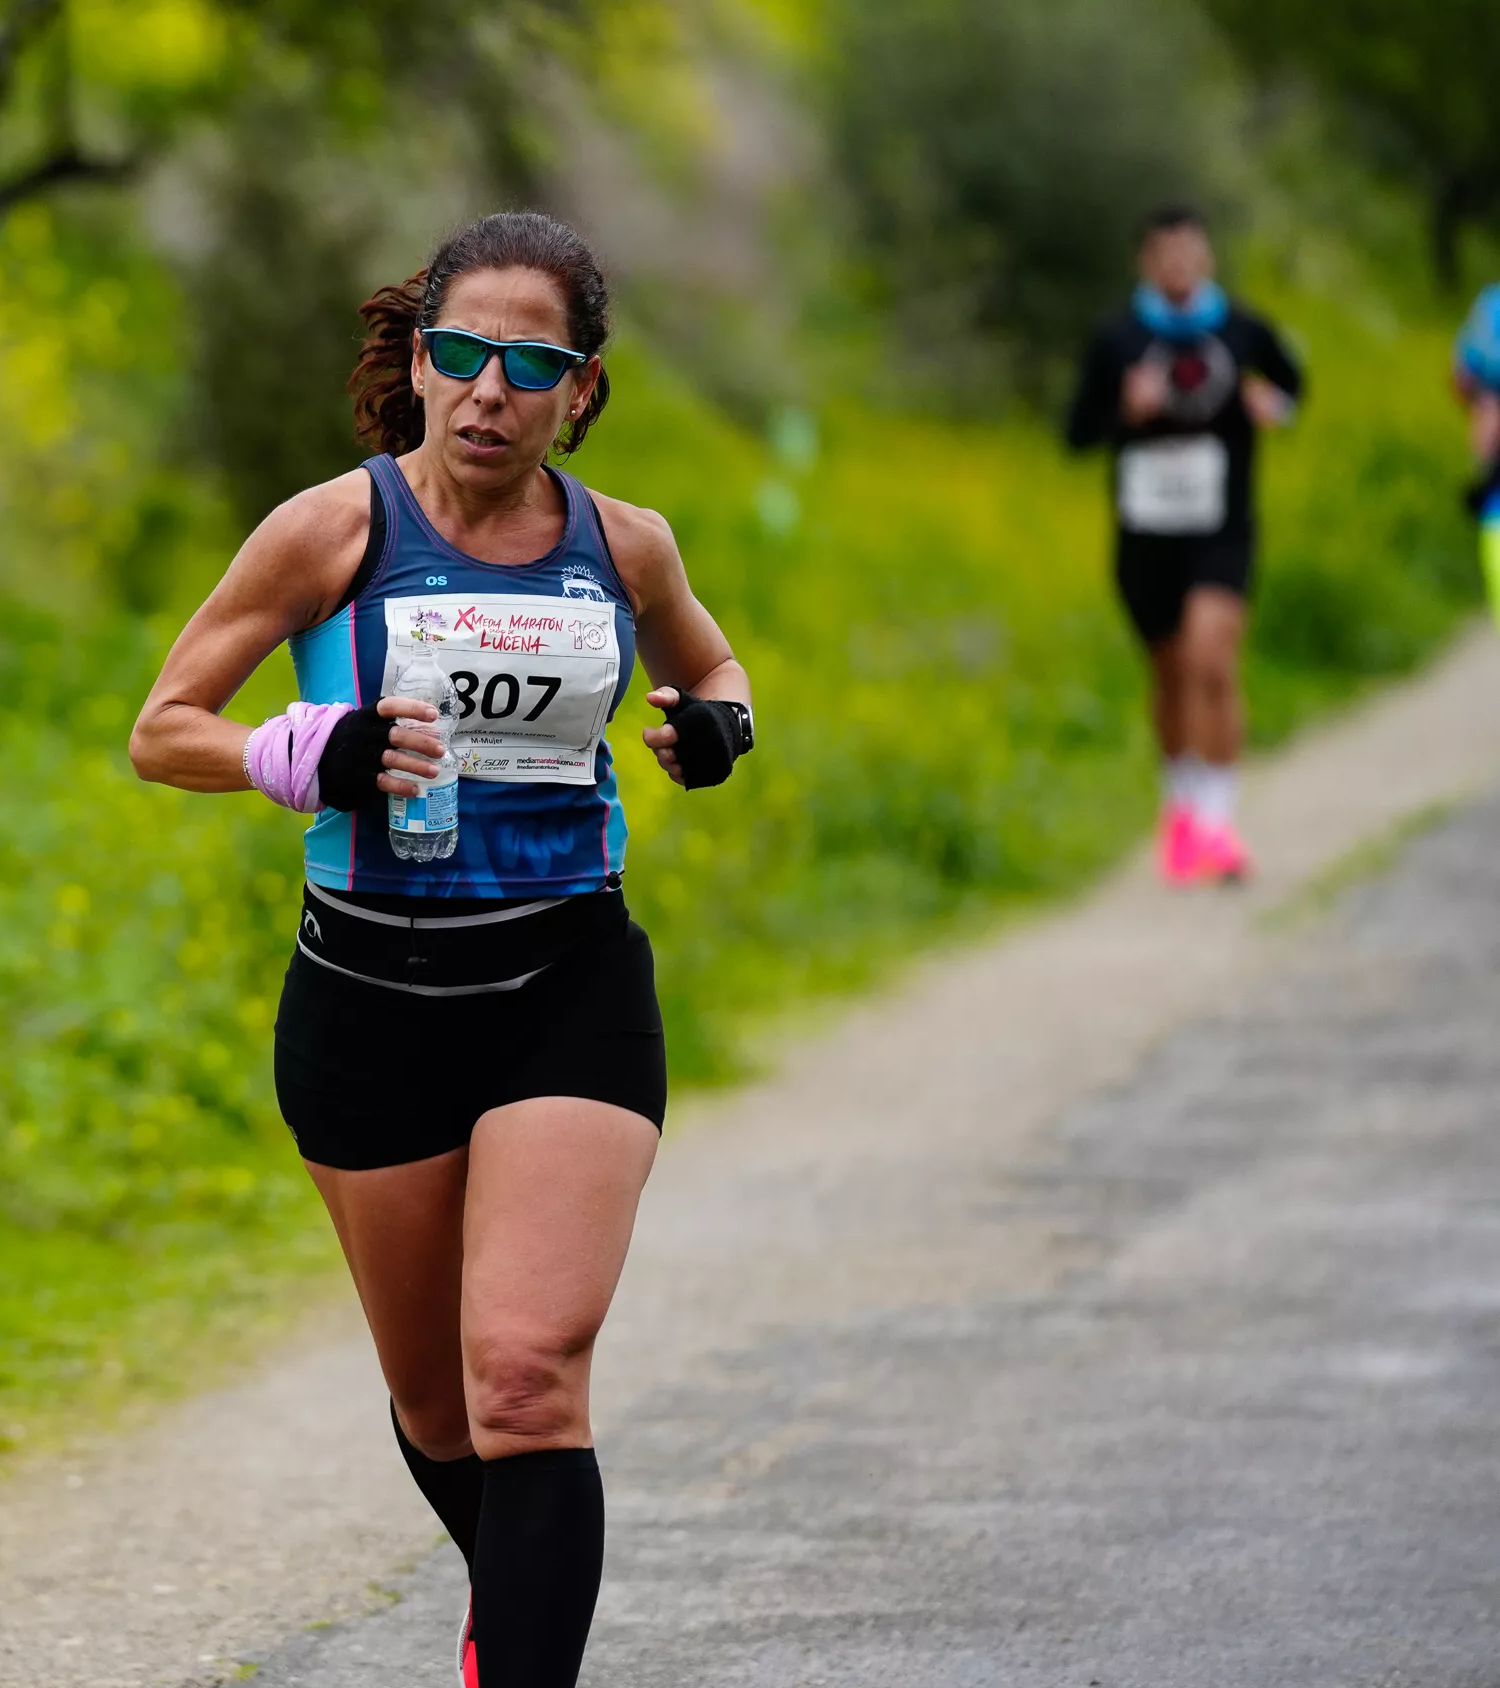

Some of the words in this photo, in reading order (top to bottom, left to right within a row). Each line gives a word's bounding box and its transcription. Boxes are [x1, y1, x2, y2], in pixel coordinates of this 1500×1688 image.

[426, 575, 448, 586] OS
[471, 613, 502, 629] MEDIA
[509, 614, 564, 632] MARATÓN
[479, 629, 551, 655] LUCENA
[449, 670, 562, 722] 807
[470, 737, 503, 745] M-Mujer
[484, 759, 510, 767] SDM
[516, 757, 586, 767] mediamaratonlucena.com
